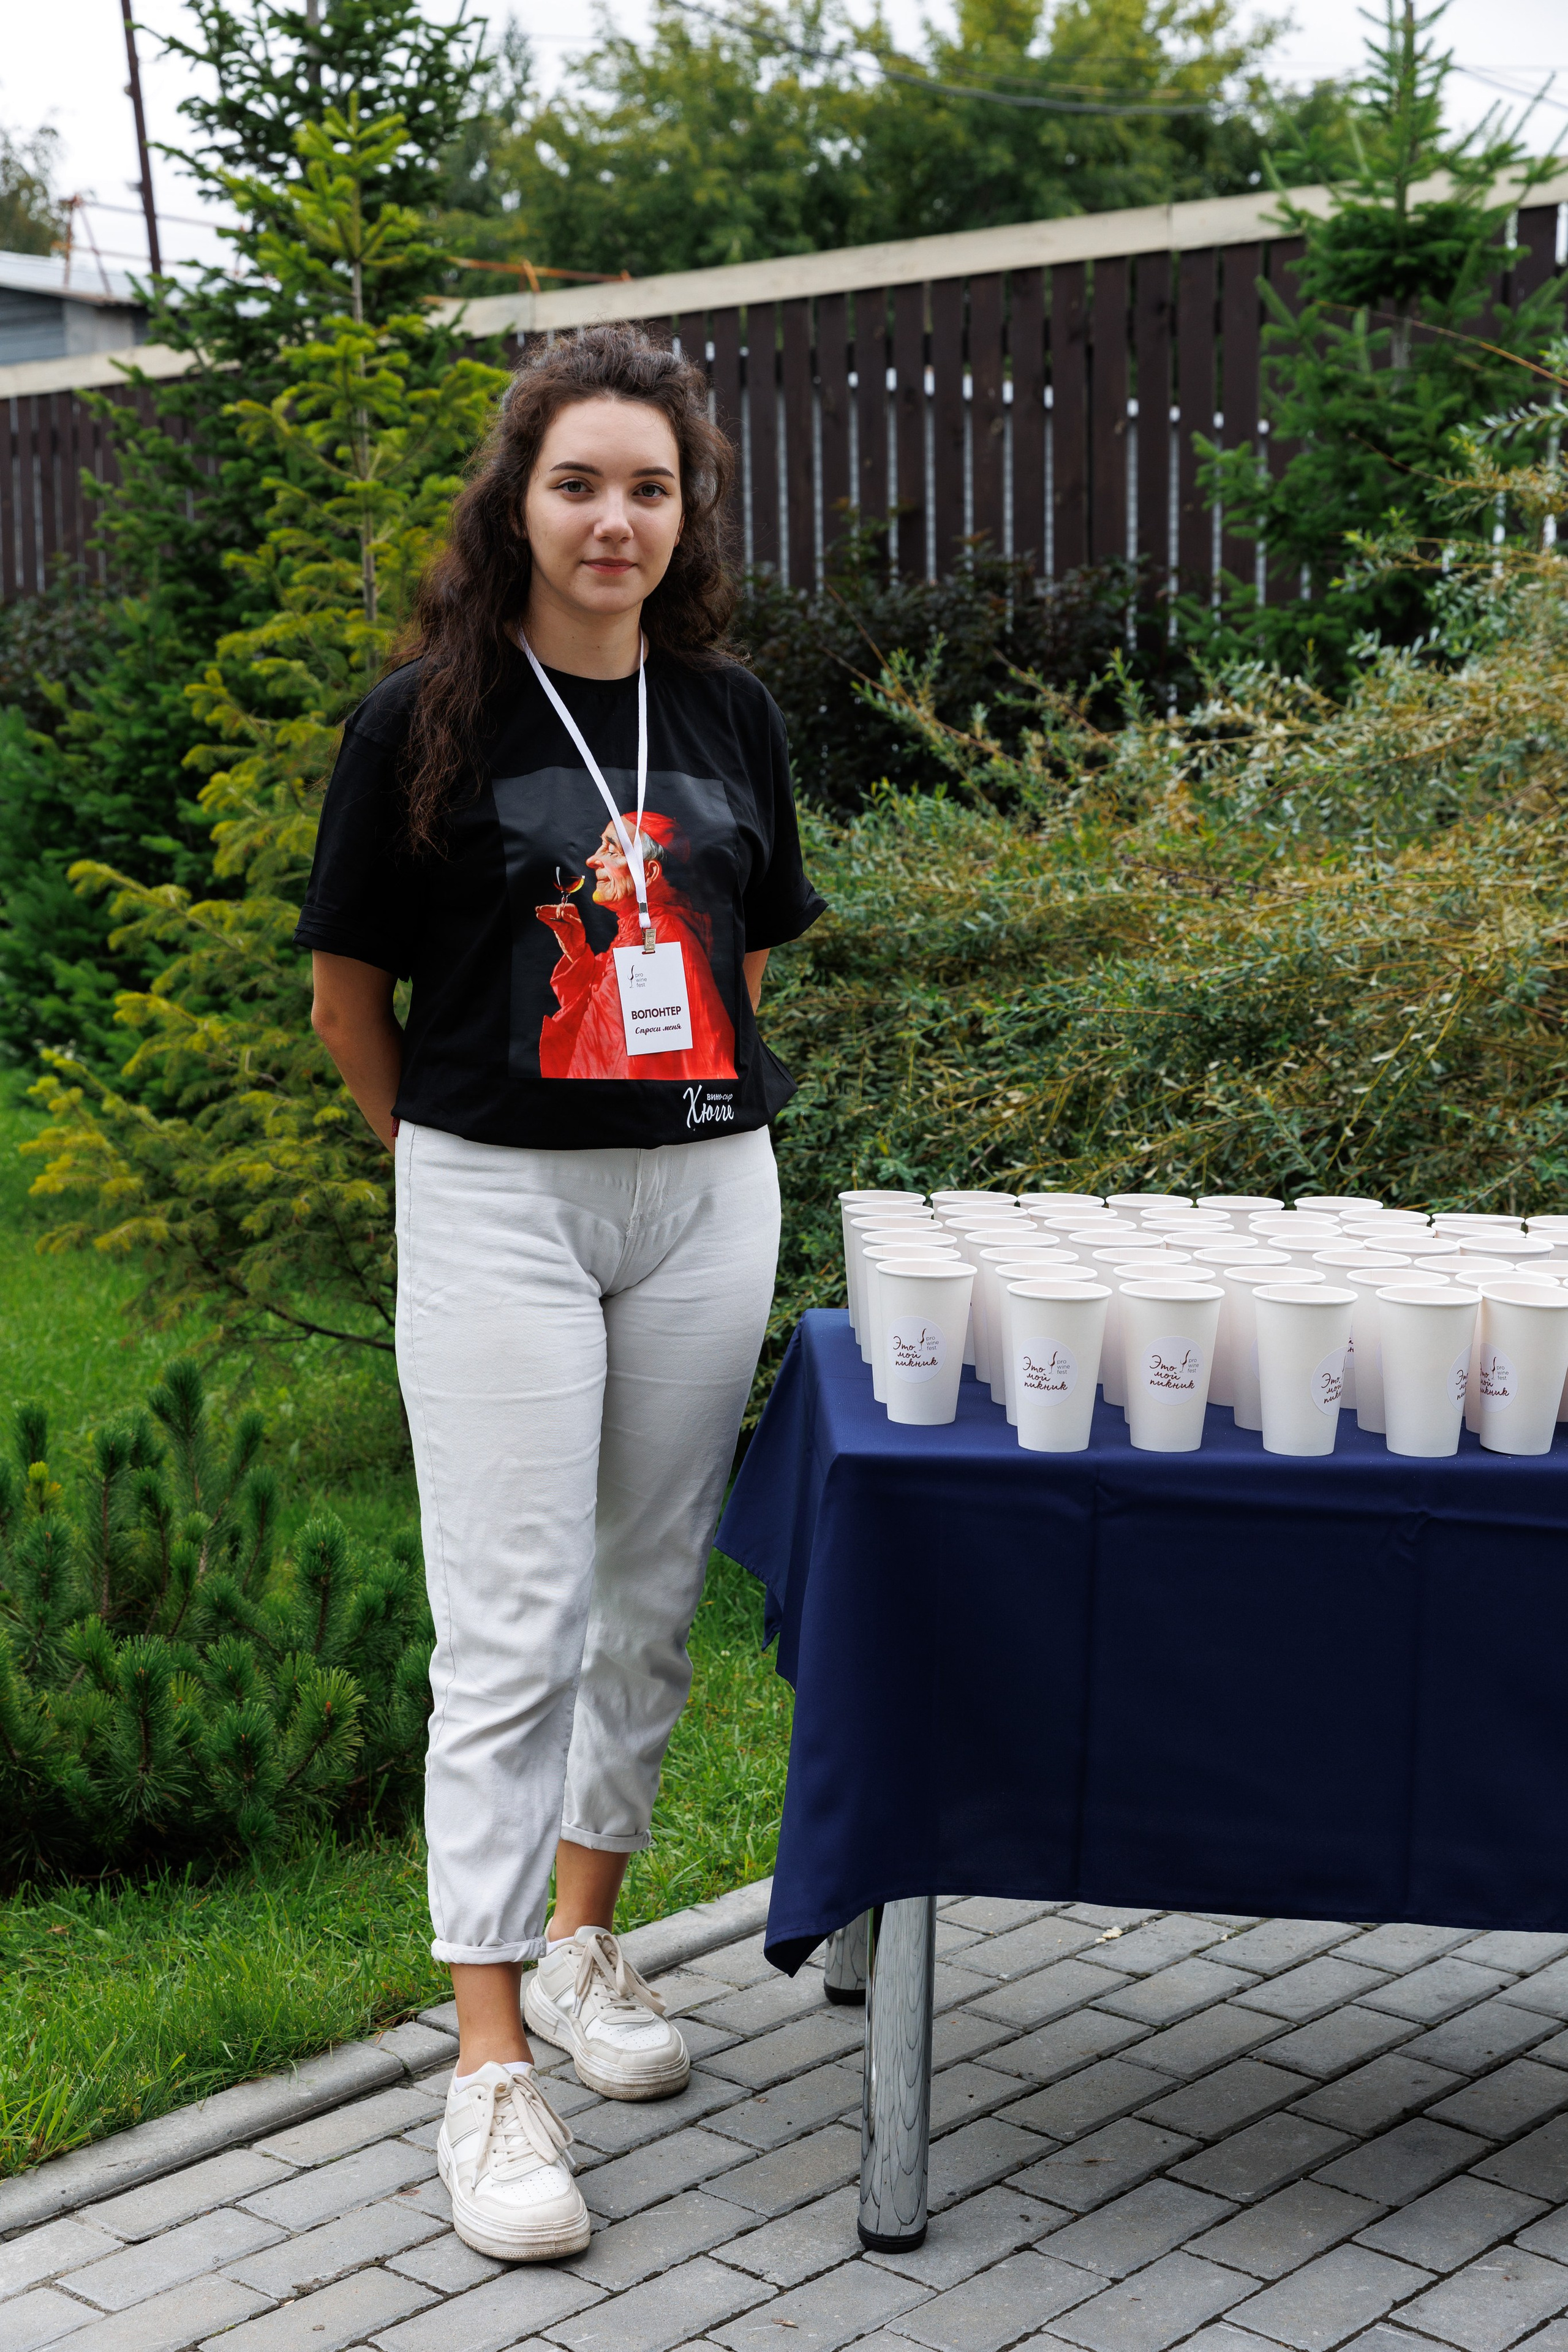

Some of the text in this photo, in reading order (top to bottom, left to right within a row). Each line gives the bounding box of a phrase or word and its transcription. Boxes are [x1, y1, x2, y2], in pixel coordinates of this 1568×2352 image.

[631, 1006, 682, 1020] ВОЛОНТЕР
[635, 1027, 662, 1036] Спроси
[682, 1084, 734, 1128] Хюгге
[892, 1336, 916, 1351] Это
[895, 1357, 938, 1367] пикник
[1022, 1356, 1046, 1373] Это
[1149, 1355, 1177, 1371] Это
[1027, 1373, 1051, 1382] мой
[1154, 1371, 1181, 1380] мой
[1321, 1373, 1341, 1389] Это
[1024, 1381, 1068, 1391] пикник
[1150, 1379, 1195, 1389] пикник
